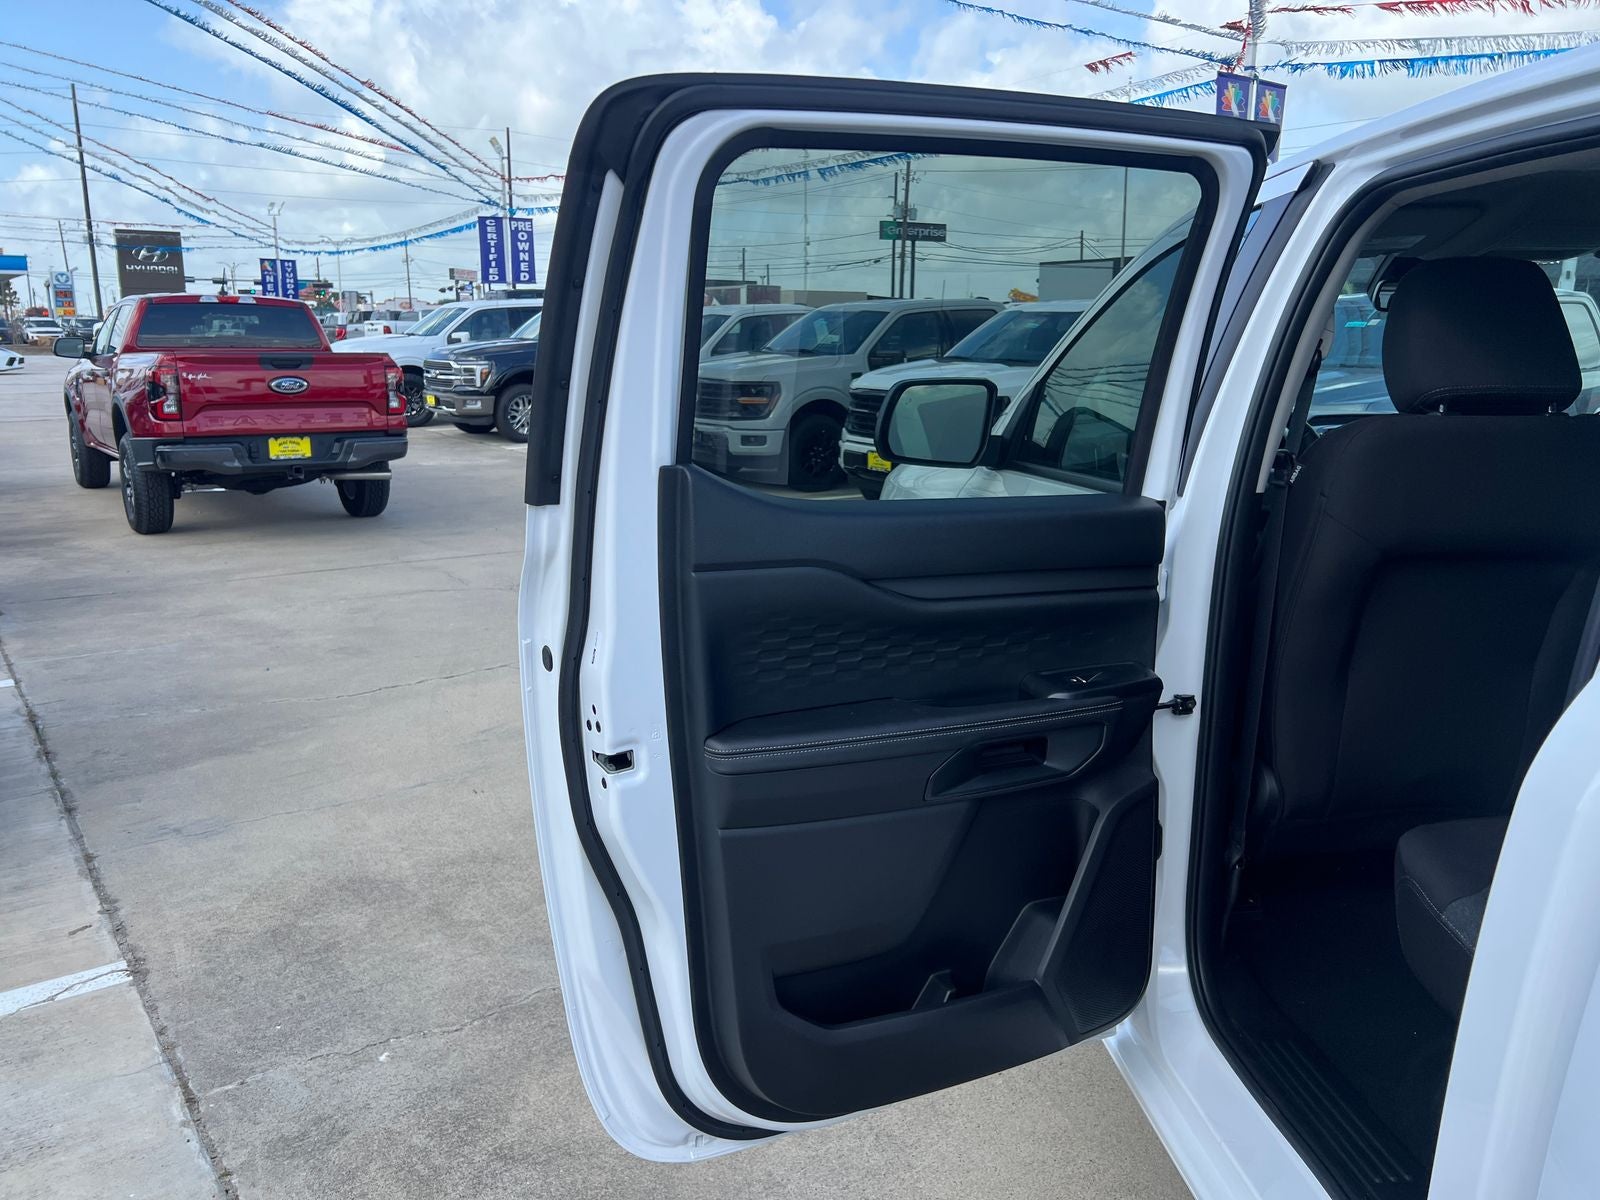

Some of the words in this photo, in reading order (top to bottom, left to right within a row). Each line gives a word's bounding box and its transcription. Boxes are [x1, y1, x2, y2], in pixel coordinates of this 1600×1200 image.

[511, 220, 532, 231] PRE
[887, 225, 945, 238] enerprise
[485, 219, 499, 281] CERTIFIED
[517, 231, 530, 281] OWNED
[125, 264, 178, 274] HYUNDAI
[265, 275, 276, 297] NEW
[284, 261, 295, 299] HYUNDAI
[280, 380, 301, 391] Ford
